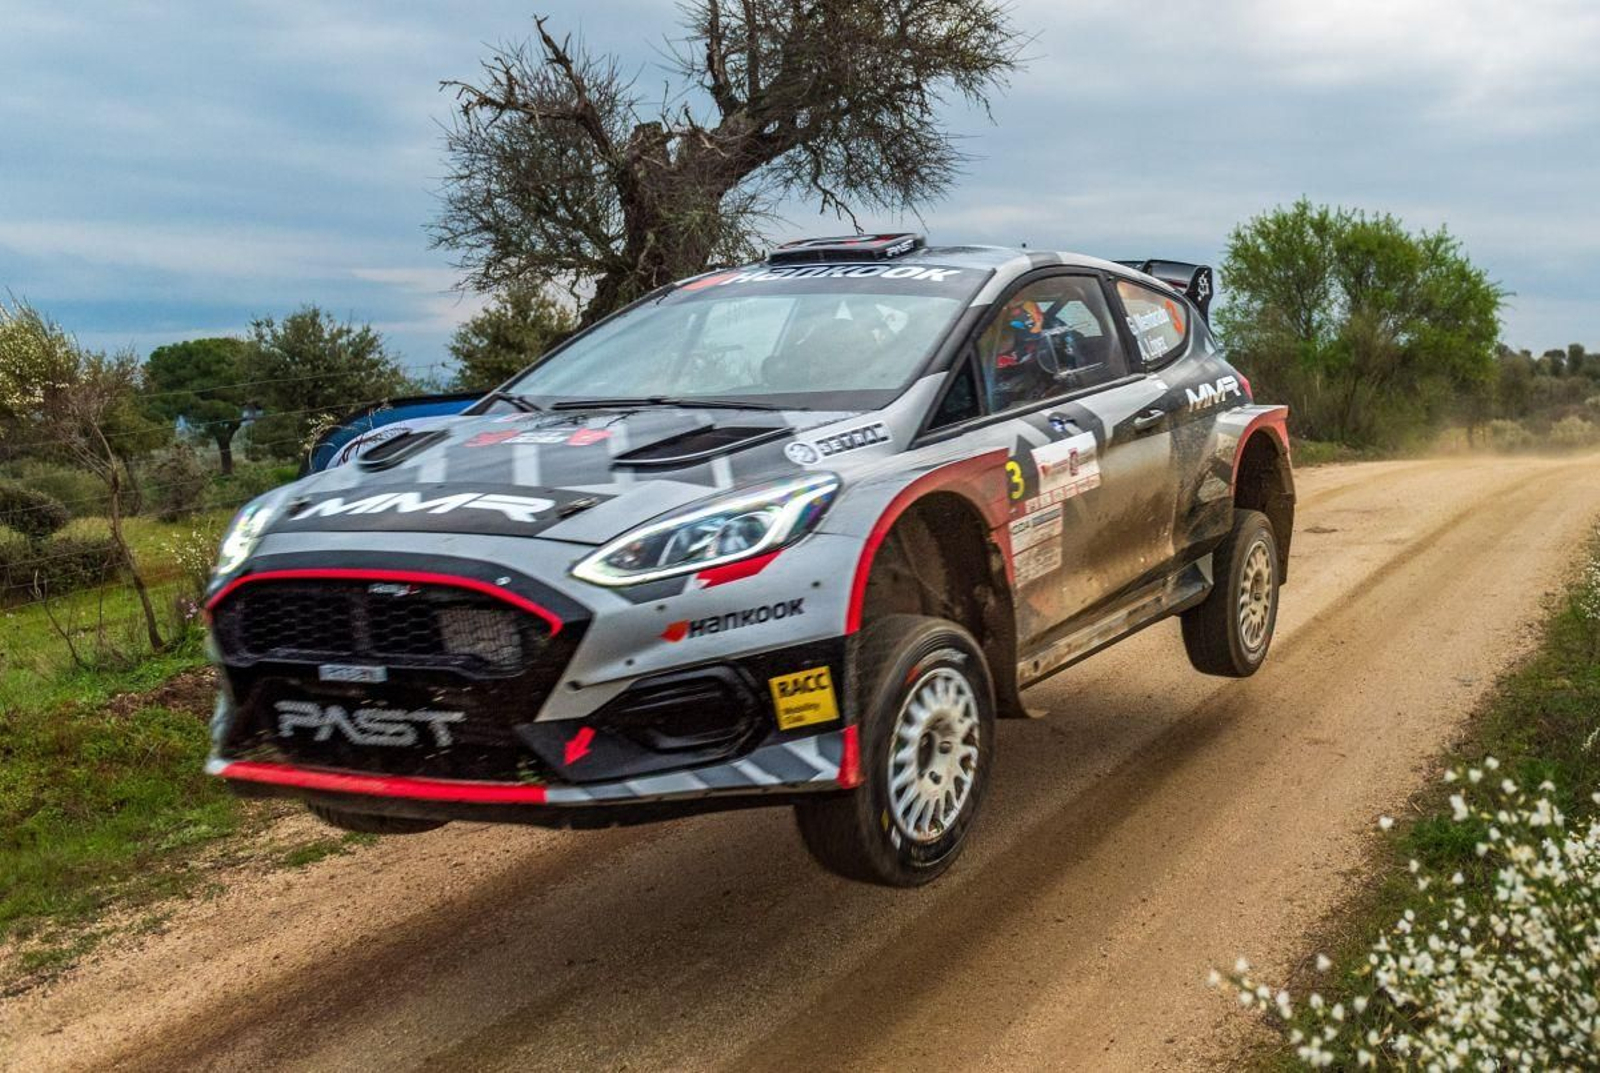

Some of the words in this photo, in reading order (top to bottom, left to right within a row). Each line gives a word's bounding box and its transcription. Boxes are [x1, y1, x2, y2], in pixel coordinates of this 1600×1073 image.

[1185, 375, 1241, 413] MMR
[1005, 460, 1025, 499] 3
[288, 492, 555, 523] MMR
[778, 671, 829, 698] RACC
[273, 700, 467, 747] PAST
